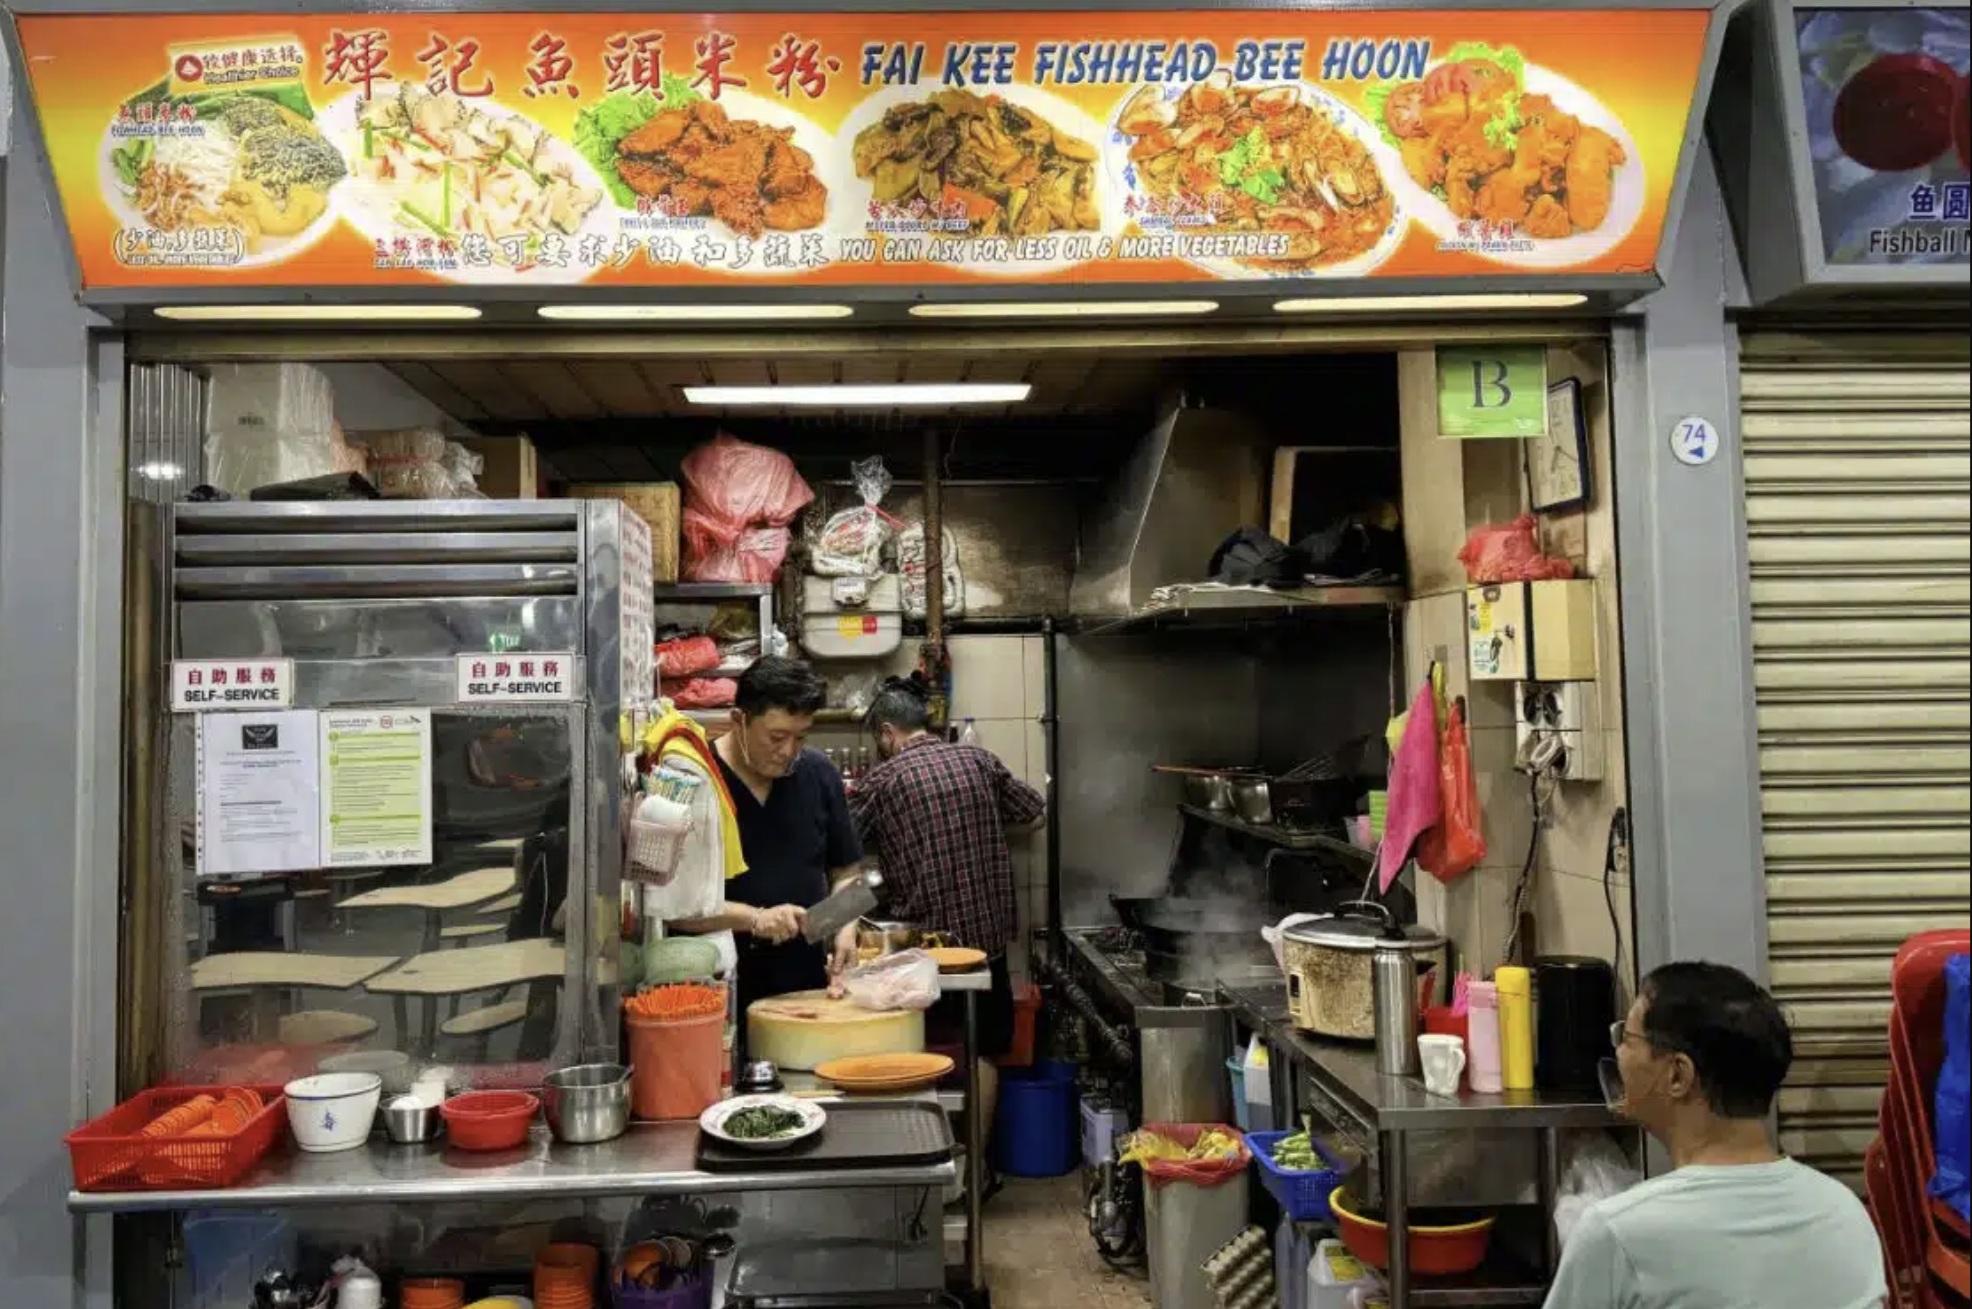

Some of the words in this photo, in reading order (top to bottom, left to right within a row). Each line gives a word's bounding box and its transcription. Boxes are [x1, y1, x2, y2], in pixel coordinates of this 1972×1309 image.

[324, 30, 840, 100] 輝記魚頭米粉
[862, 42, 924, 85] FAI
[942, 44, 1016, 86] KEE
[1034, 42, 1217, 84] FISHHEAD
[1231, 42, 1304, 81] BEE
[1321, 40, 1430, 80] HOON
[203, 69, 257, 85] Healthier
[257, 65, 300, 78] Choice
[1909, 184, 1970, 219] 鱼圆
[460, 233, 829, 268] 您可要求少油和多蔬菜
[840, 237, 876, 262] YOU
[884, 237, 922, 262] CAN
[927, 237, 965, 262] ASK
[971, 237, 1009, 262] FOR
[1014, 237, 1058, 262] LESS
[1064, 236, 1092, 259] OIL
[1098, 236, 1113, 257] &
[1119, 235, 1174, 258] MORE
[1178, 233, 1290, 258] VEGETABLES
[1870, 230, 1955, 253] Fishball
[1472, 361, 1511, 407] B
[1681, 424, 1706, 442] 74
[188, 667, 275, 685] 自助服務
[472, 661, 558, 678] 自助服務
[184, 689, 279, 702] SELF-SERVICE
[468, 682, 562, 694] SELF-SERVICE
